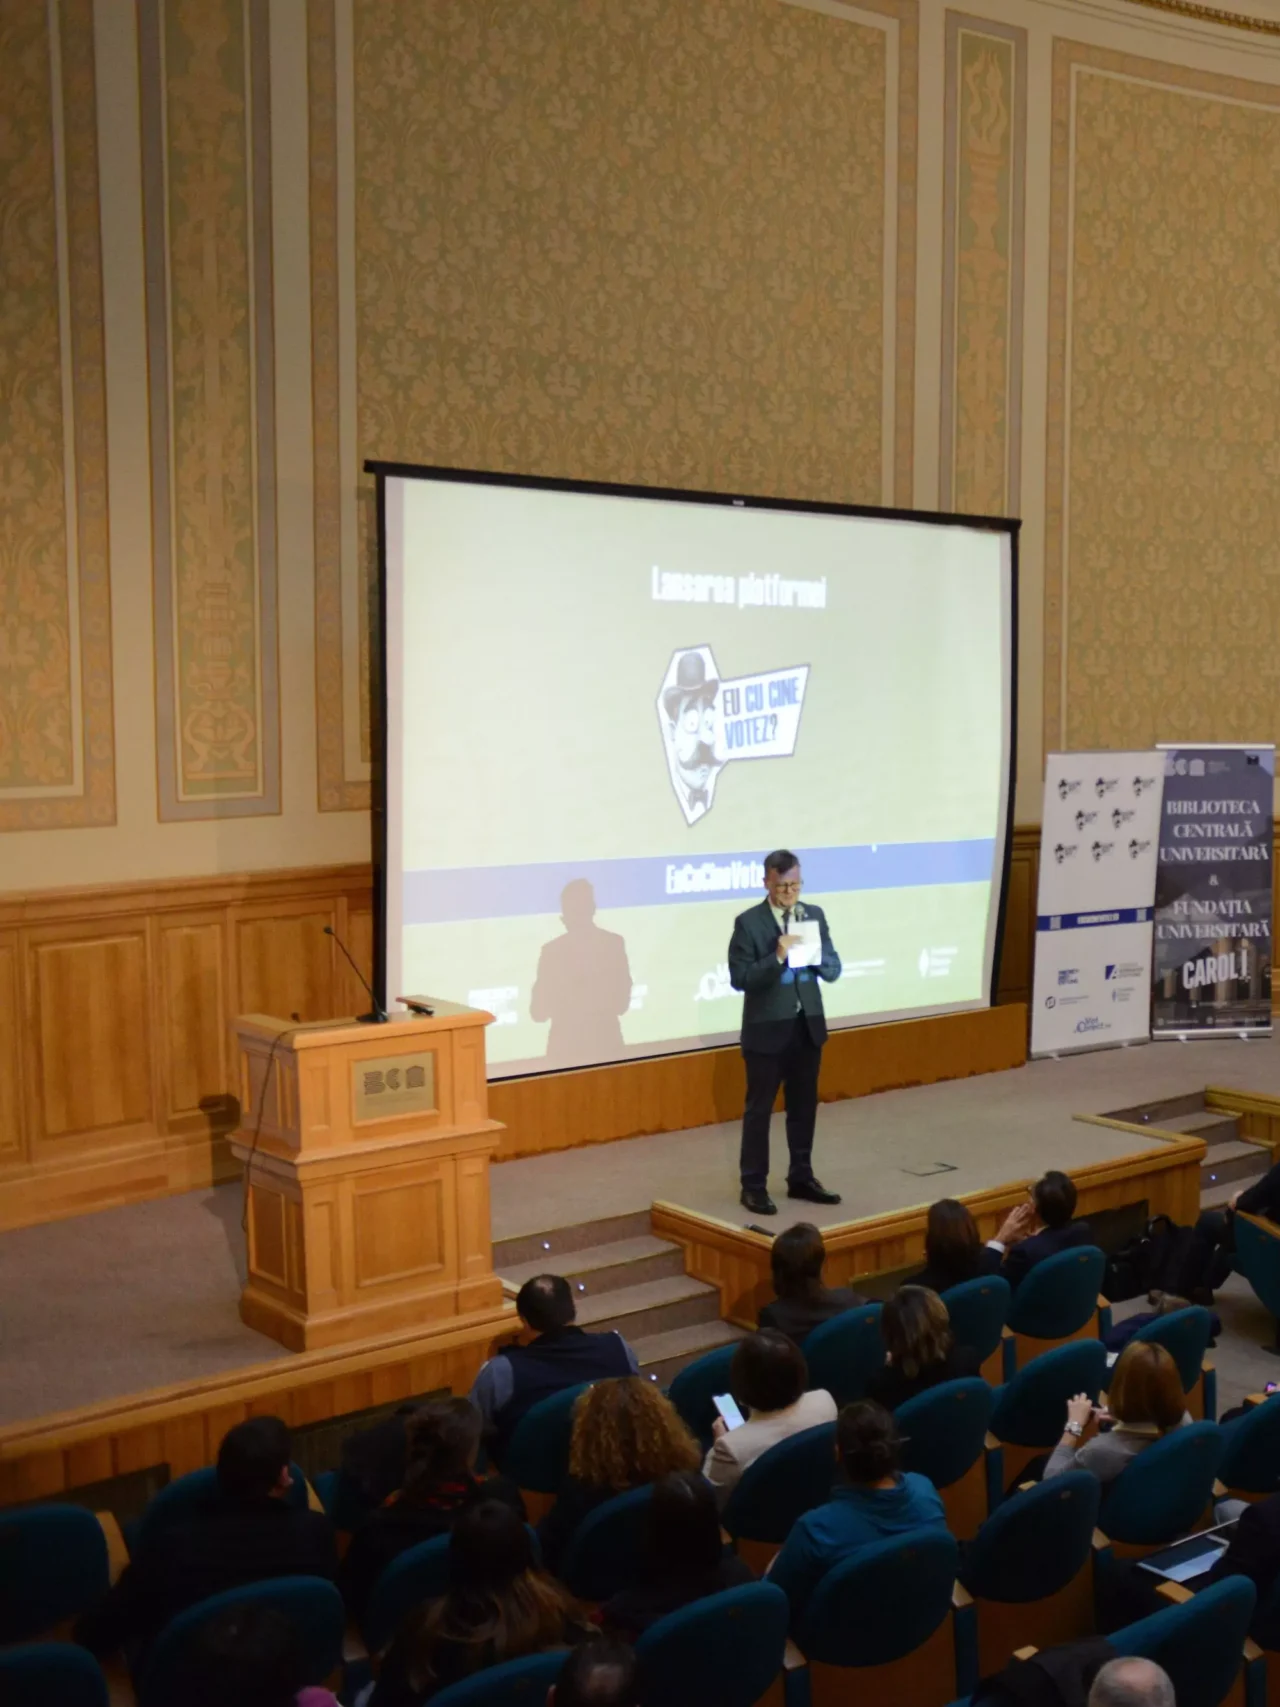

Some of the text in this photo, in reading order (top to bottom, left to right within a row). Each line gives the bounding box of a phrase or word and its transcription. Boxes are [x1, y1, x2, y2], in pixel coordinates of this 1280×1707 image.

[722, 676, 800, 717] EU CU CINE
[724, 713, 778, 749] VOTEZ?
[1166, 800, 1260, 815] BIBLIOTECA
[1173, 820, 1253, 838] CENTRALĂ
[1160, 843, 1269, 861] UNIVERSITARĂ
[1209, 874, 1219, 886] &
[1158, 920, 1270, 939] UNIVERSITARĂ
[1182, 952, 1239, 990] CAROL
